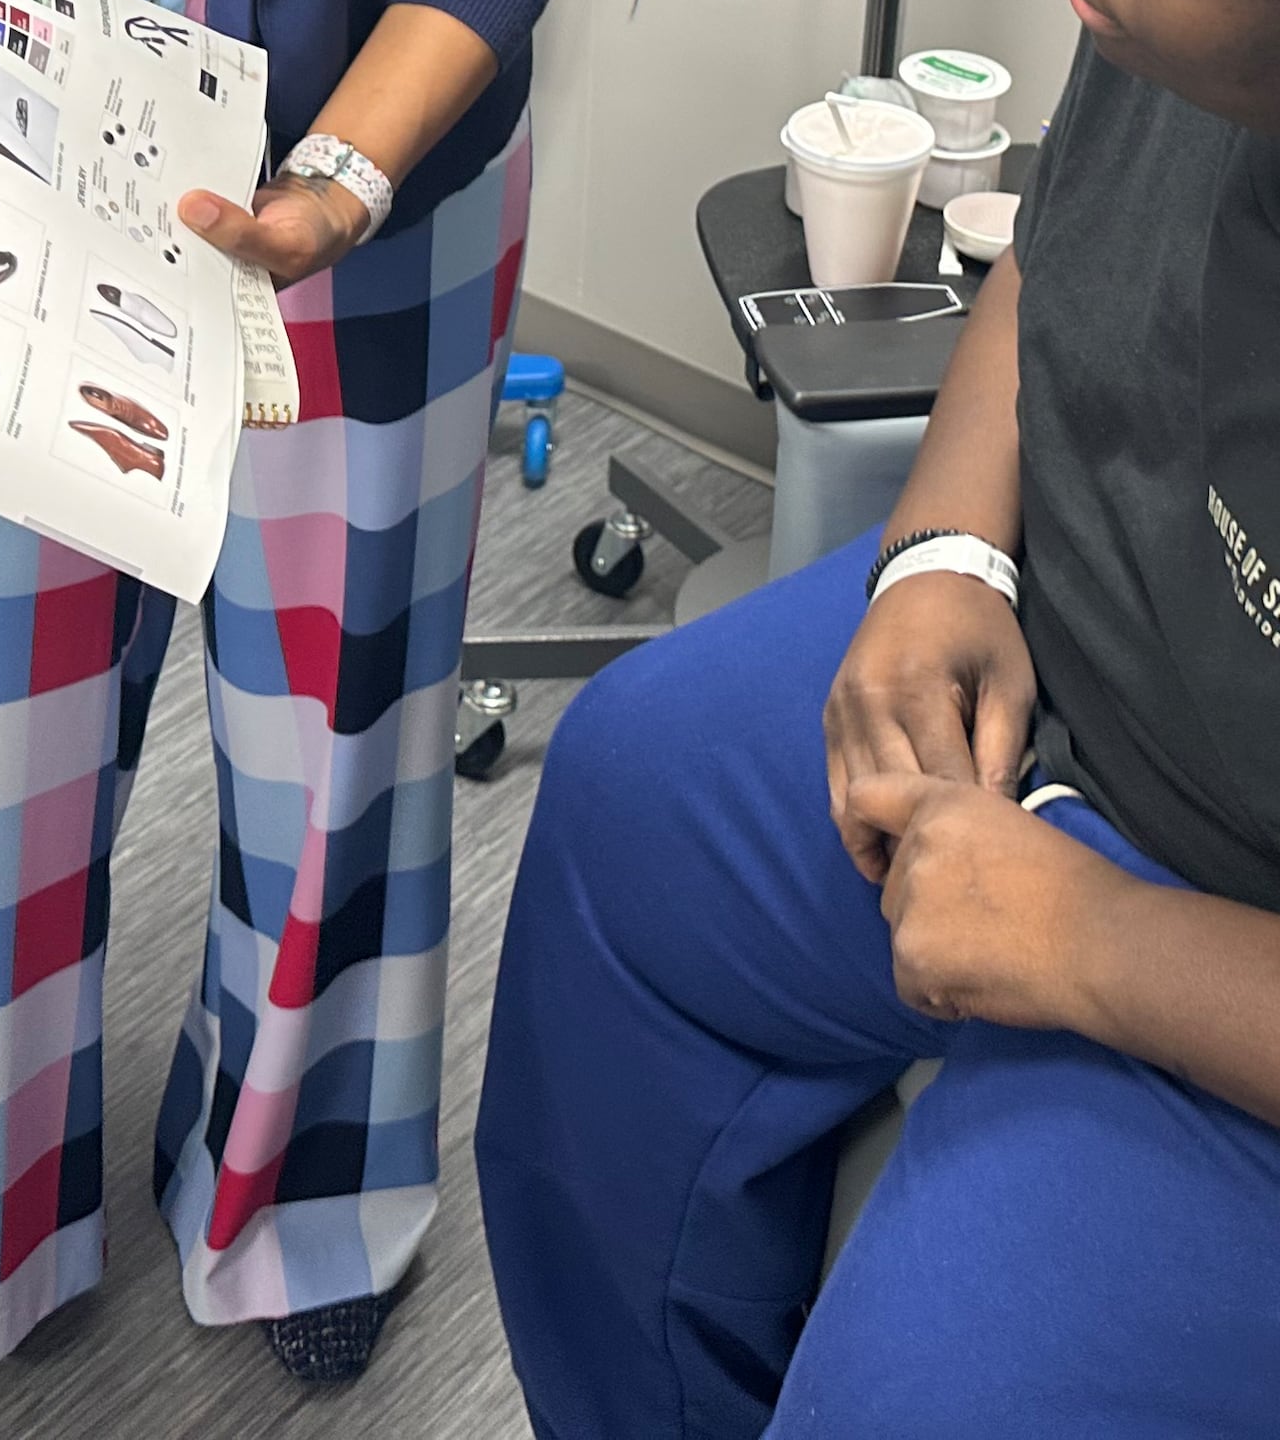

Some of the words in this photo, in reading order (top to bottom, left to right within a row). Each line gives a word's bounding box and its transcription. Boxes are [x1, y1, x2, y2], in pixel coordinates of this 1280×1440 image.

[78, 163, 88, 209] JEWELRY
[1207, 484, 1247, 560] HOUSE
[1240, 547, 1267, 587] OF
